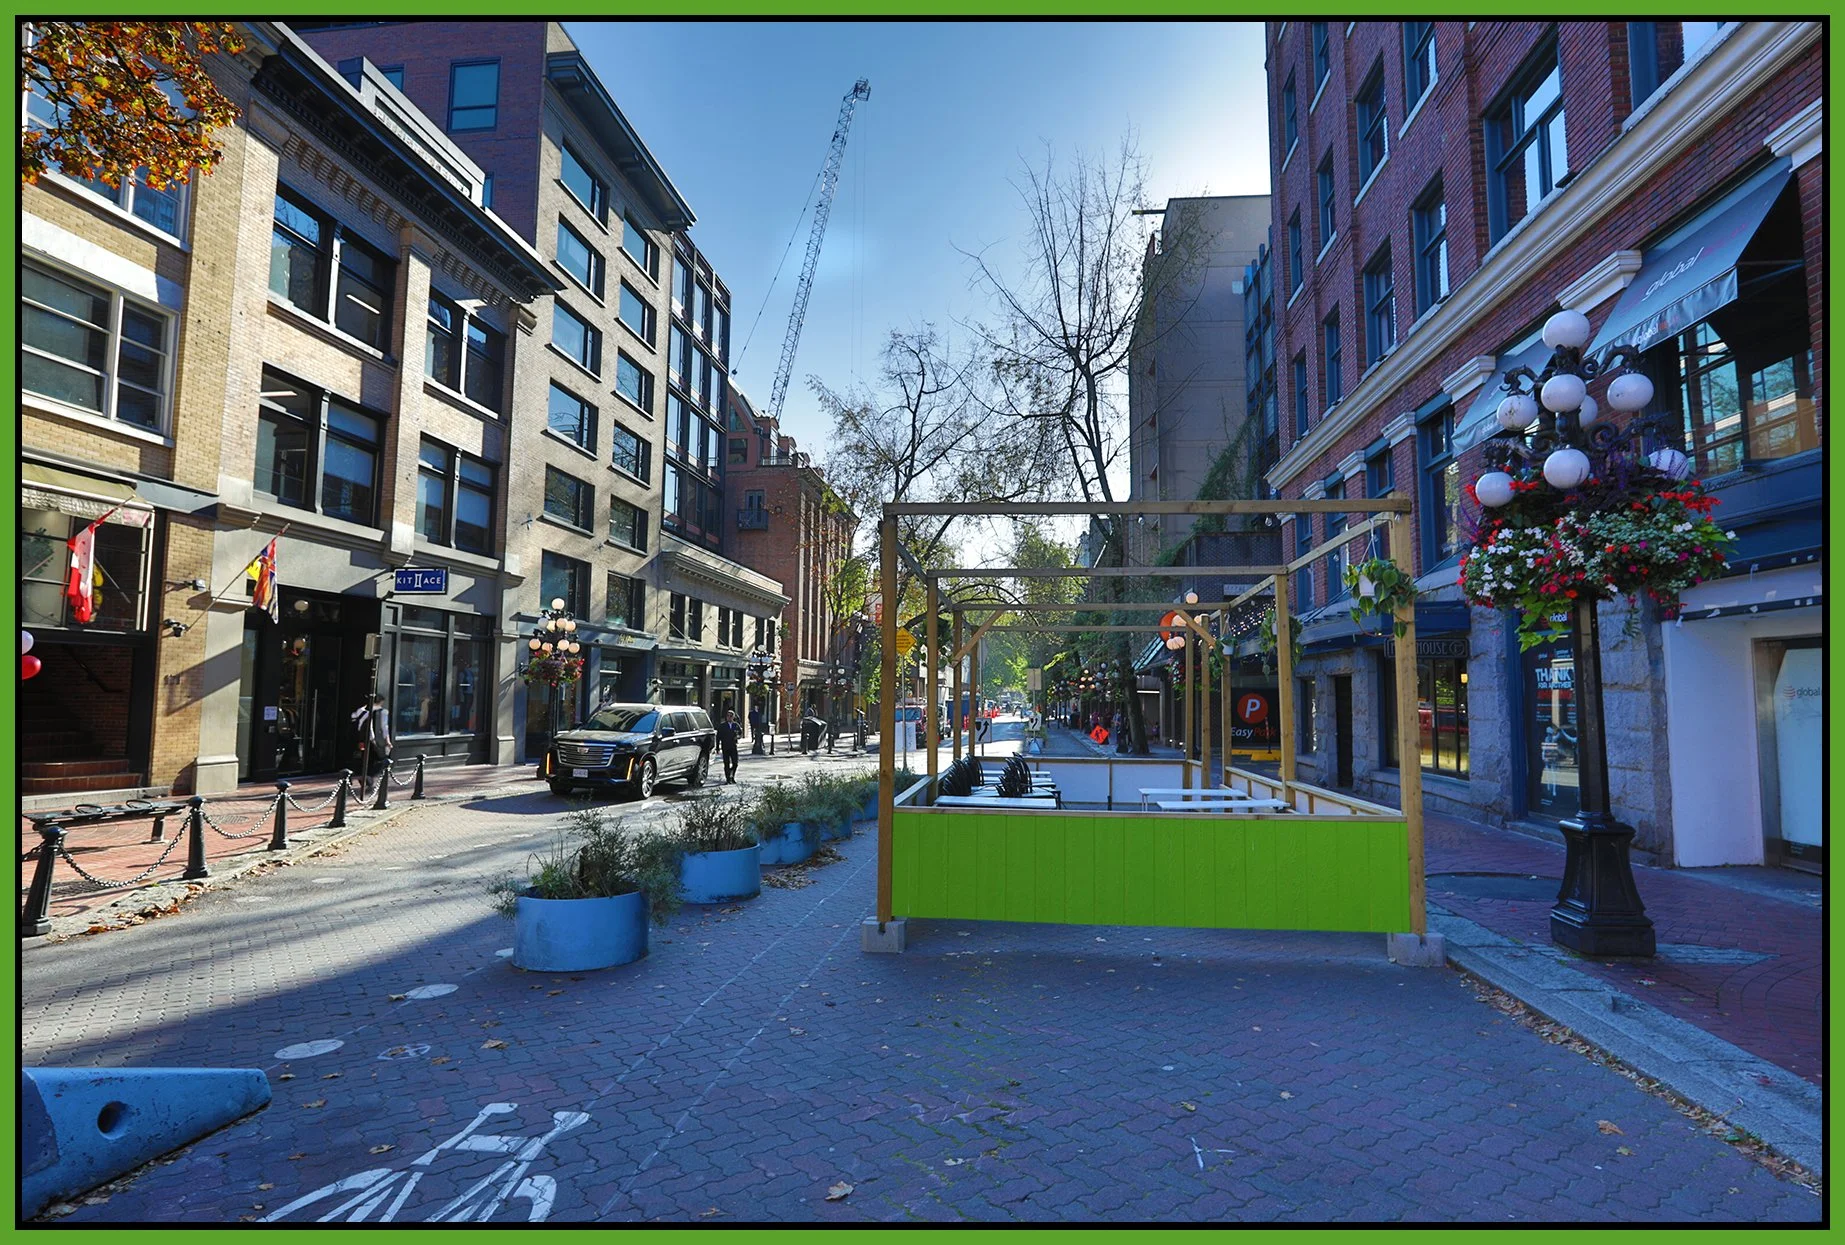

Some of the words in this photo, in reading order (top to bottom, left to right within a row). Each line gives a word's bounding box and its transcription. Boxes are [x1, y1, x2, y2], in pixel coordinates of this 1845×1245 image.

[1641, 246, 1705, 301] global
[396, 576, 413, 584] KIT
[423, 576, 441, 584] ACE
[1535, 668, 1571, 681] THANK
[1245, 698, 1261, 719] P
